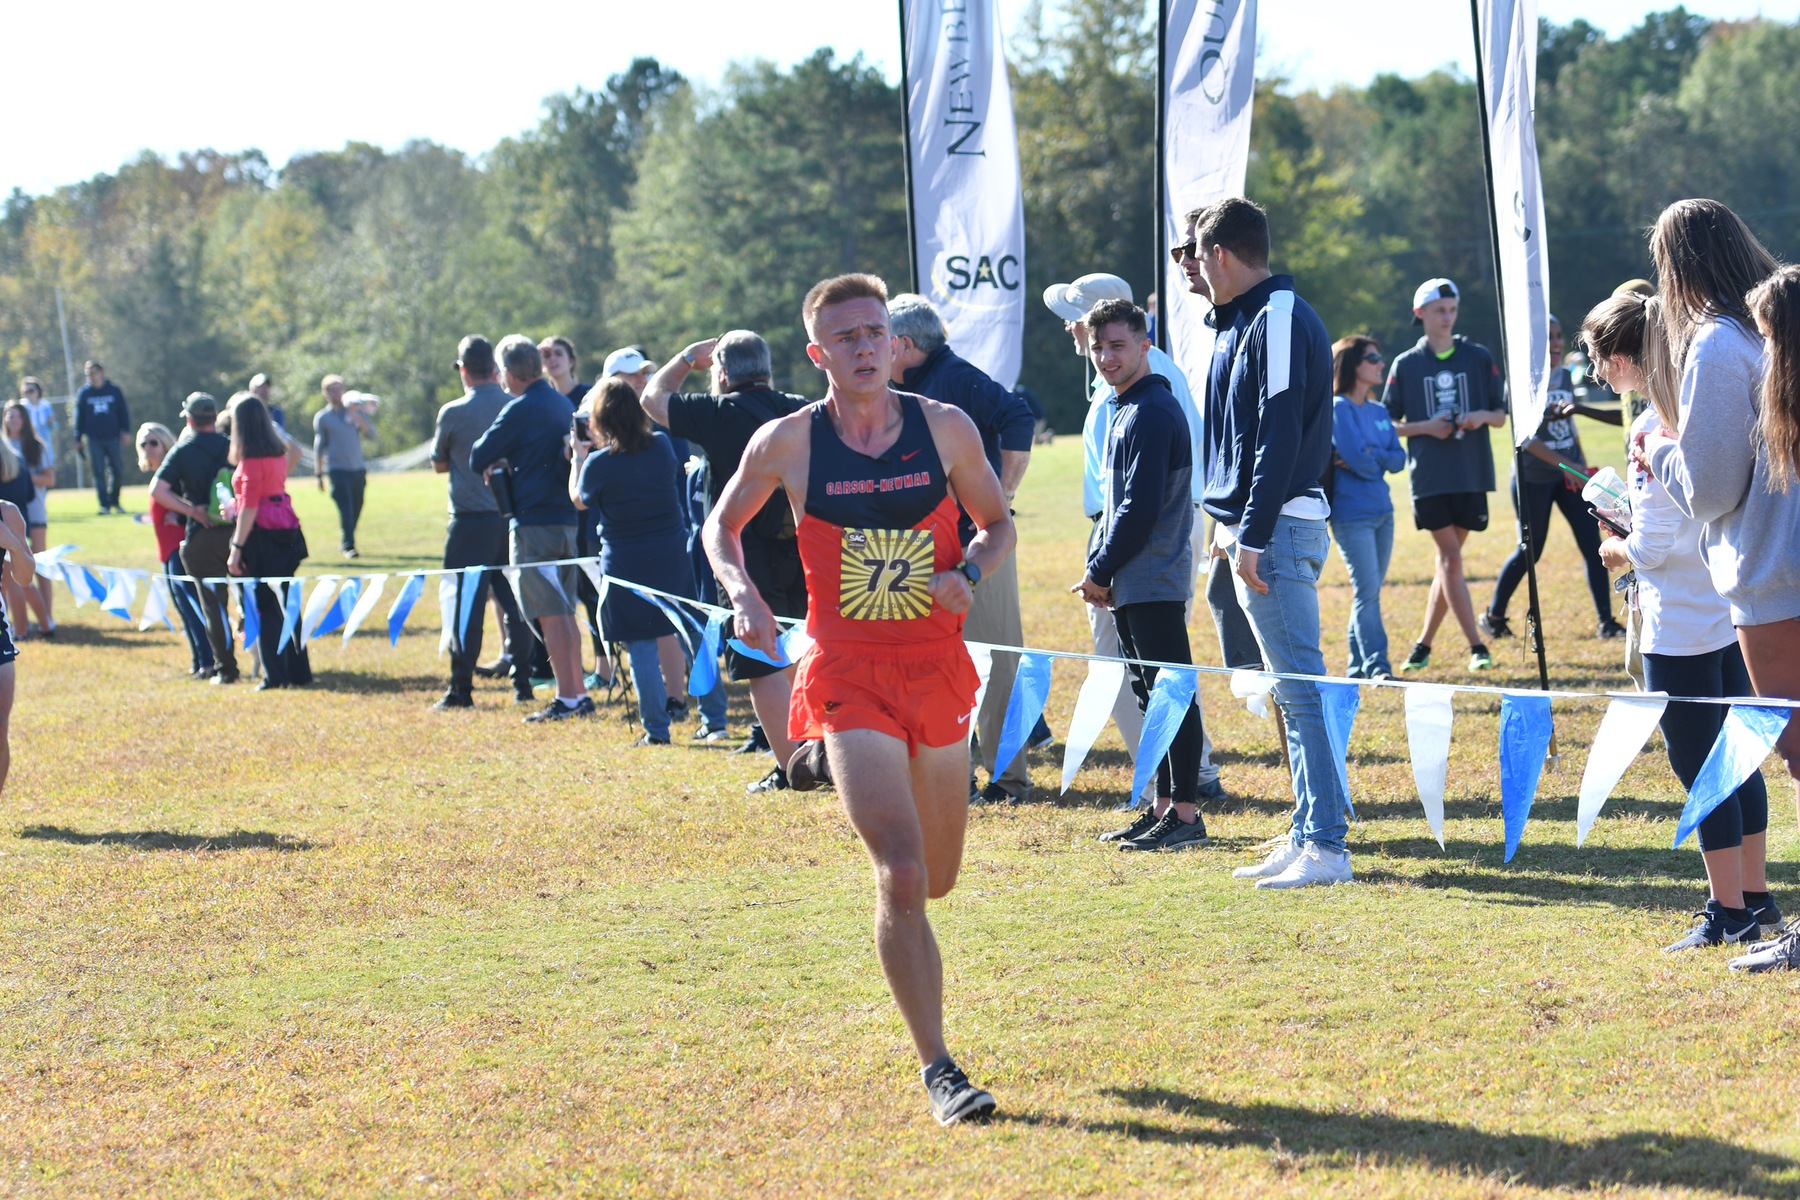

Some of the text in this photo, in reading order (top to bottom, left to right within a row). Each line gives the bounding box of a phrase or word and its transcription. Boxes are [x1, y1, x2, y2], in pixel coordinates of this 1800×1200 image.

[1200, 0, 1230, 105] QU
[946, 255, 1019, 290] SAC
[826, 471, 930, 495] CARSON-NEWMAN
[849, 534, 865, 542] SAC
[863, 558, 911, 592] 72
